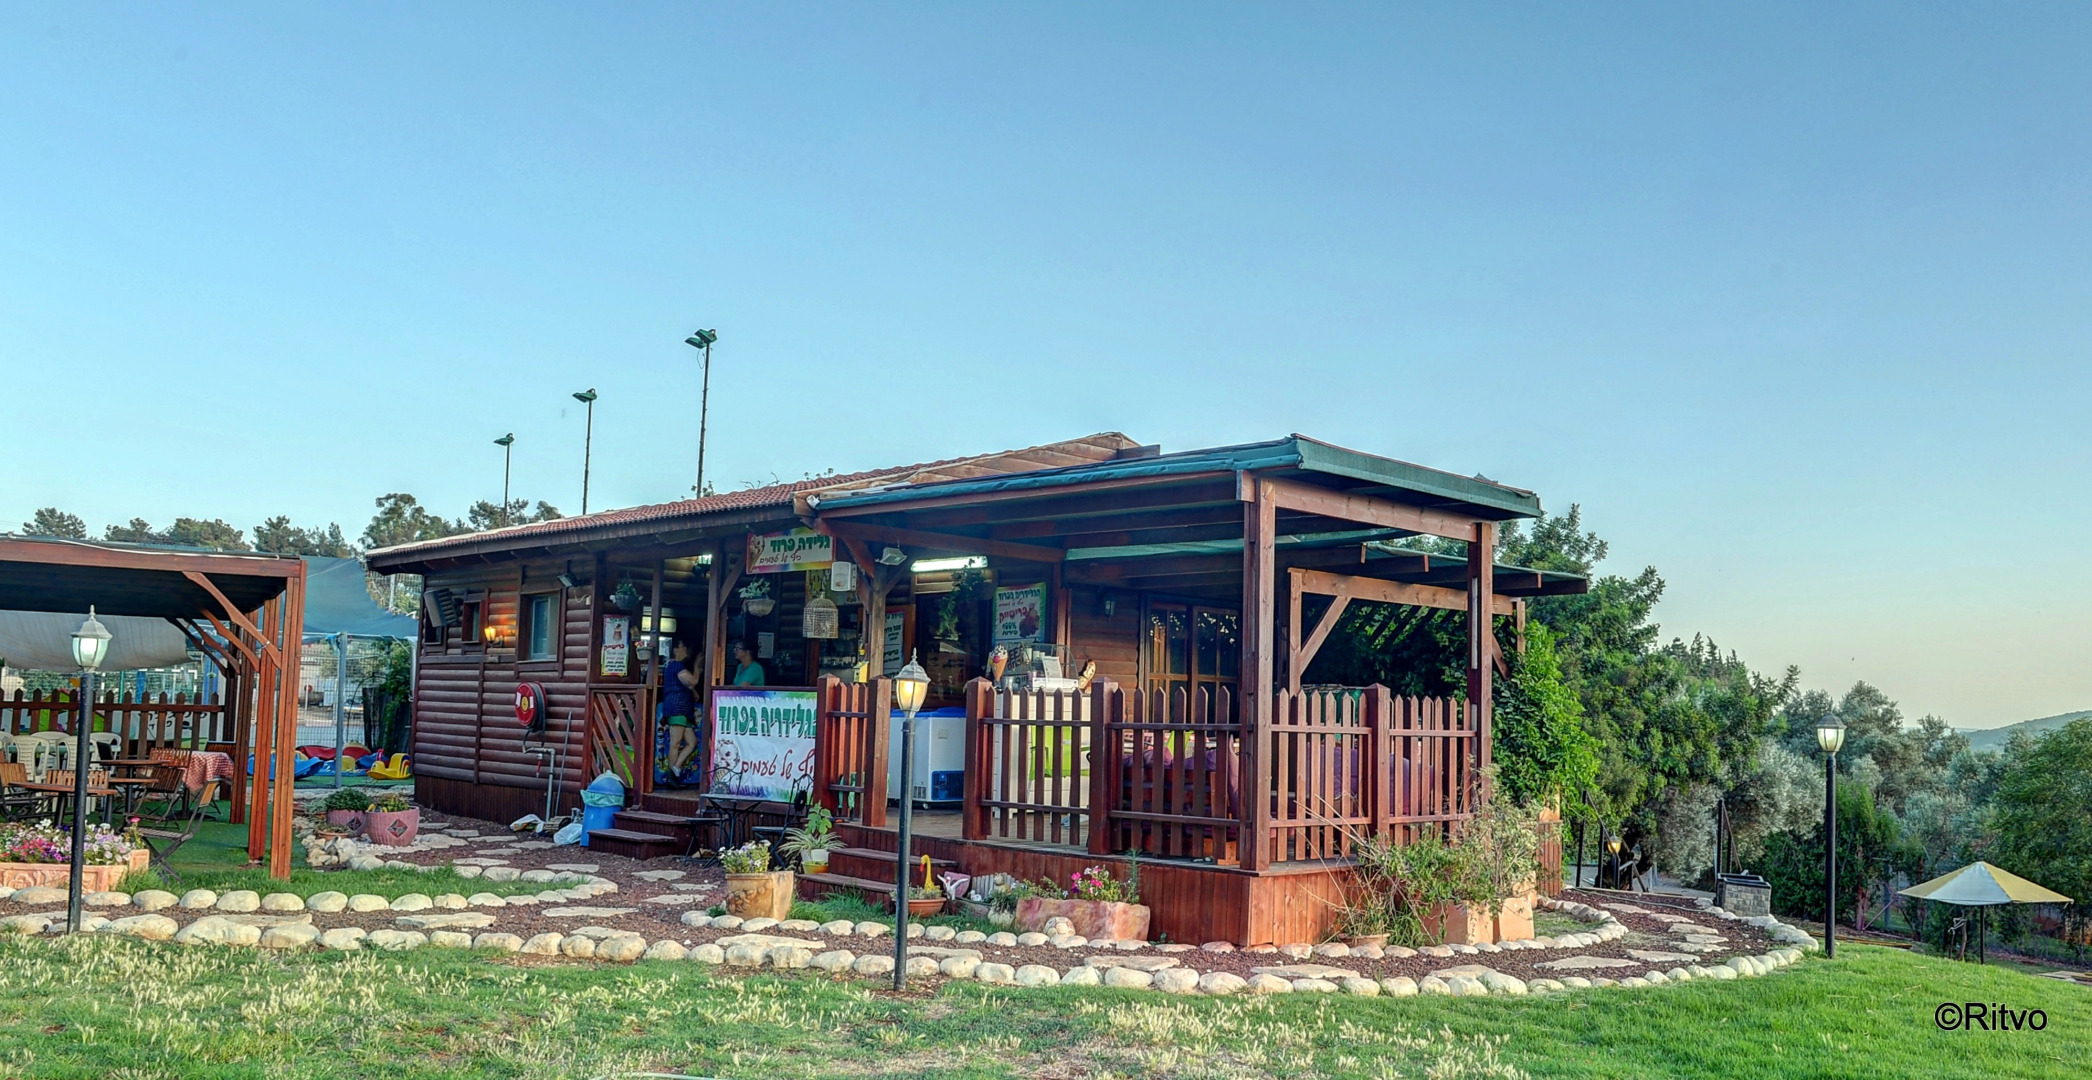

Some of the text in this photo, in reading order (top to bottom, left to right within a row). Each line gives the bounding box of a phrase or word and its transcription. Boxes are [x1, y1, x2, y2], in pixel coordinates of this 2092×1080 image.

[770, 535, 831, 553] גלידה פרוד
[718, 705, 759, 737] בפרוד
[741, 754, 778, 777] טעמים
[780, 748, 793, 780] של
